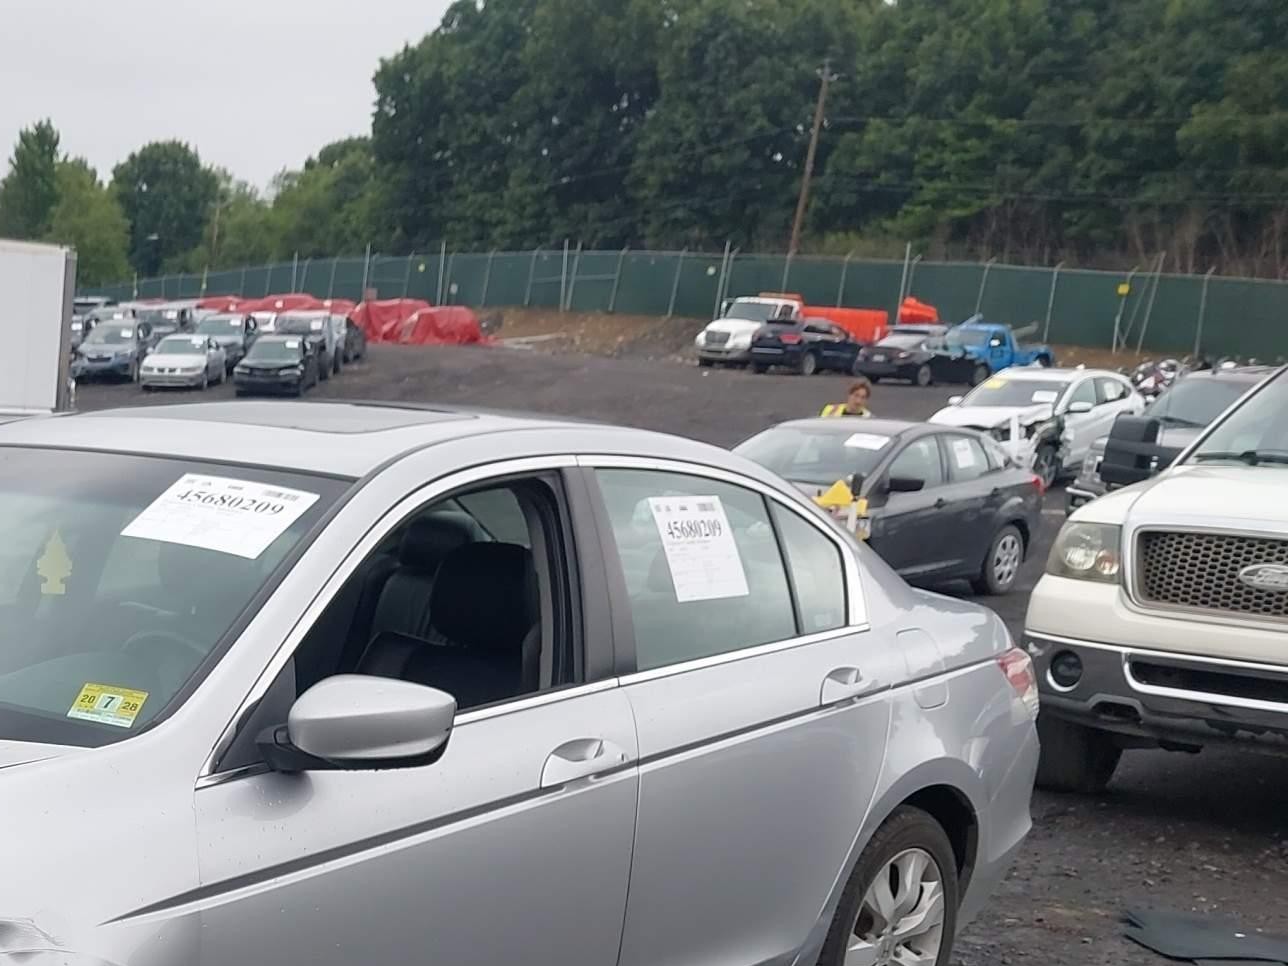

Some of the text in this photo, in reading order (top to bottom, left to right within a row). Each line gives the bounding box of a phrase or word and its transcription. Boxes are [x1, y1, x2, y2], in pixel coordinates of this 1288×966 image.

[177, 489, 285, 516] 45680209
[666, 519, 722, 540] 45680209
[80, 694, 138, 712] 20 7 28
